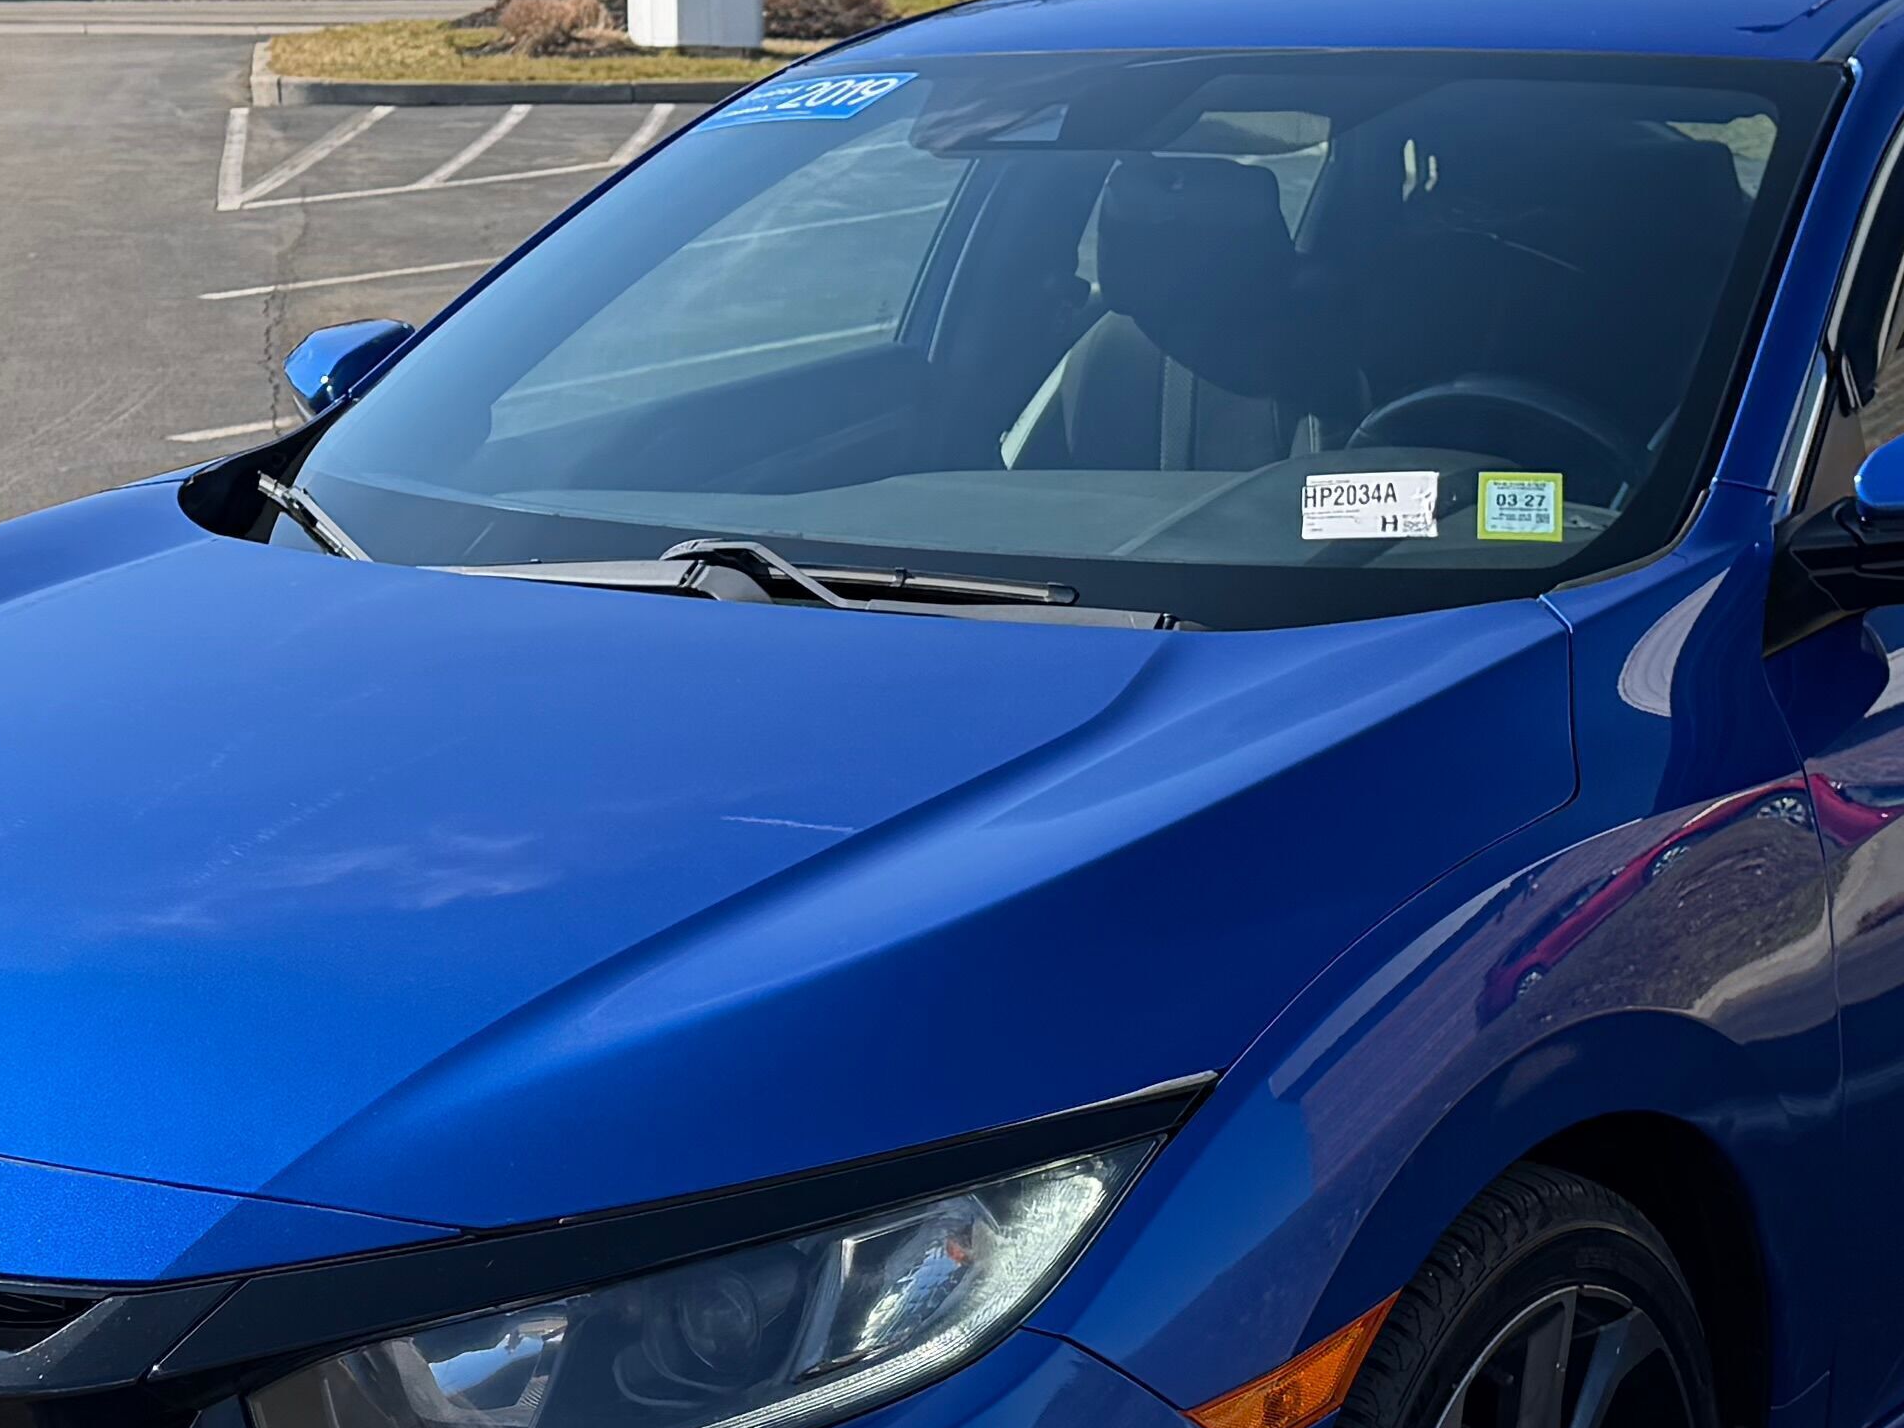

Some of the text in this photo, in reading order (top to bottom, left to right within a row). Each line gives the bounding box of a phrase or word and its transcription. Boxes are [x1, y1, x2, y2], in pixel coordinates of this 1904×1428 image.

[776, 77, 900, 110] 2019
[1304, 482, 1398, 509] HP2034A
[1496, 493, 1546, 508] 03 27
